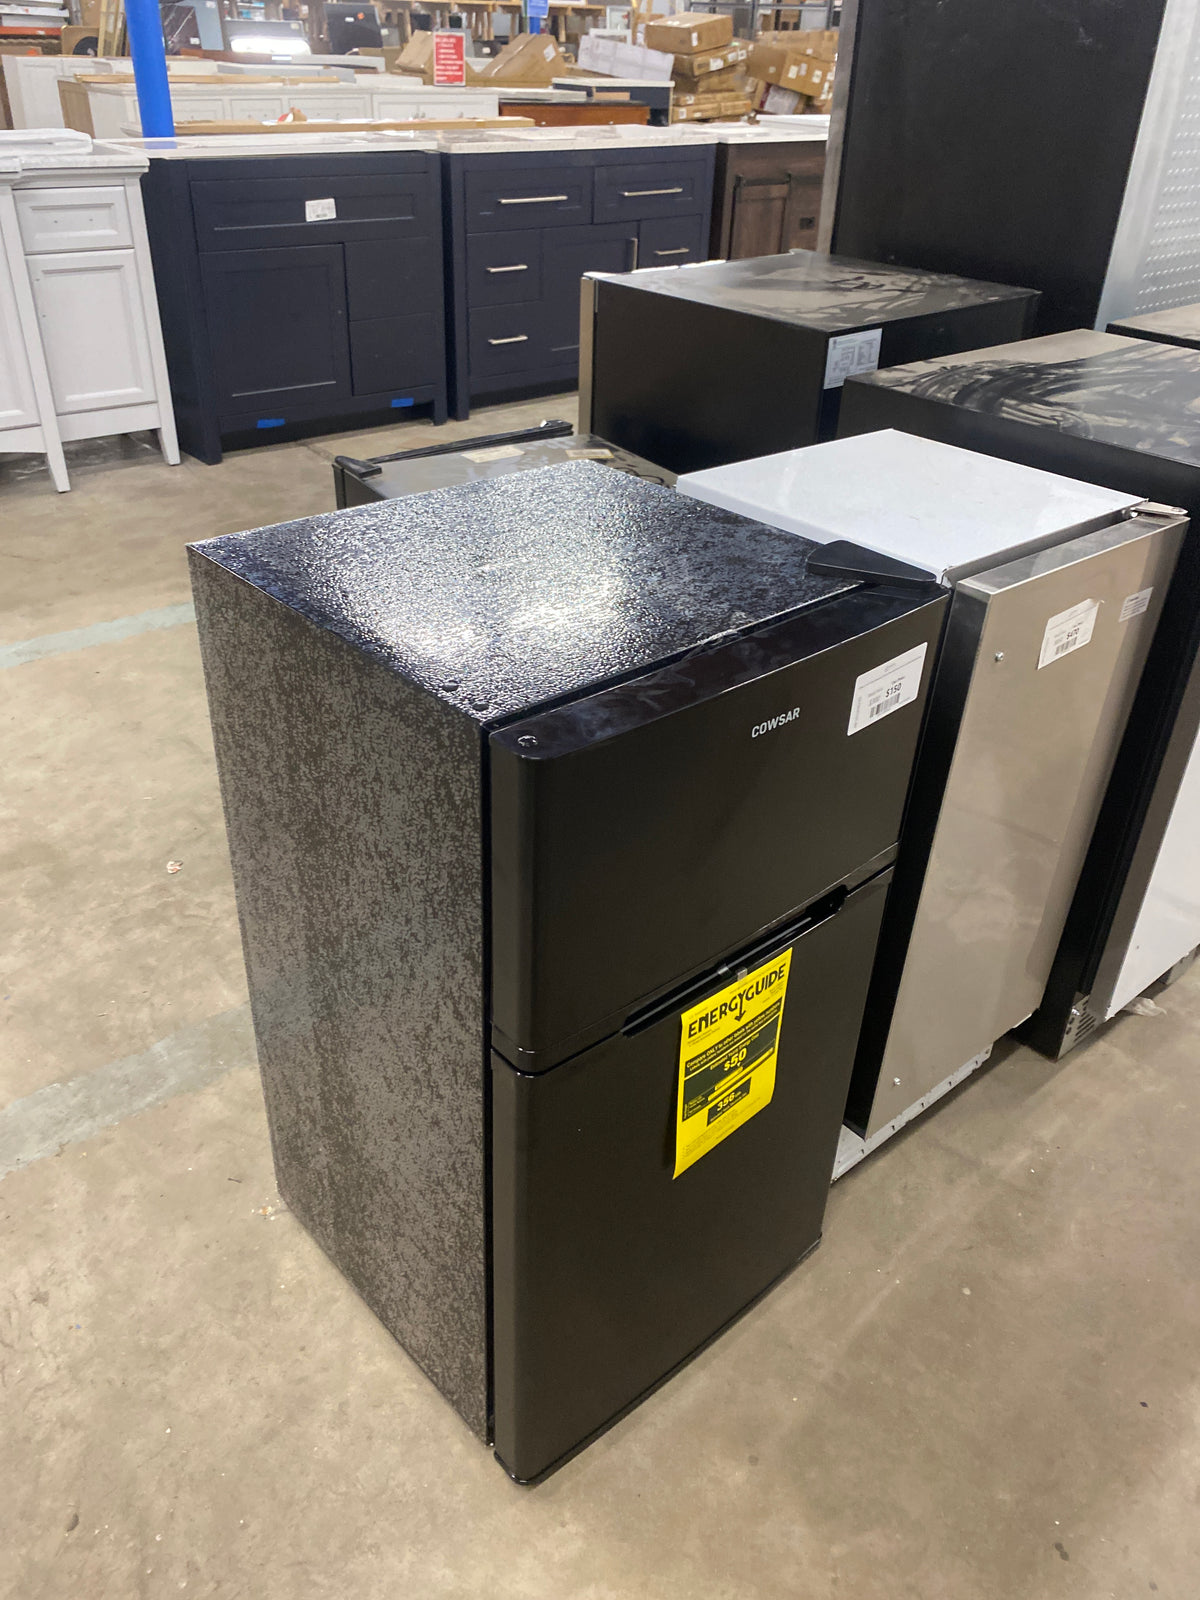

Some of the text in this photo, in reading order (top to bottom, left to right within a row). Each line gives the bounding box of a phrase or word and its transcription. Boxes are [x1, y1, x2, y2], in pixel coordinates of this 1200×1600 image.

[885, 682, 902, 698] $150
[751, 707, 801, 738] COWSAR
[723, 1047, 747, 1071] $50
[716, 1091, 735, 1112] 356
